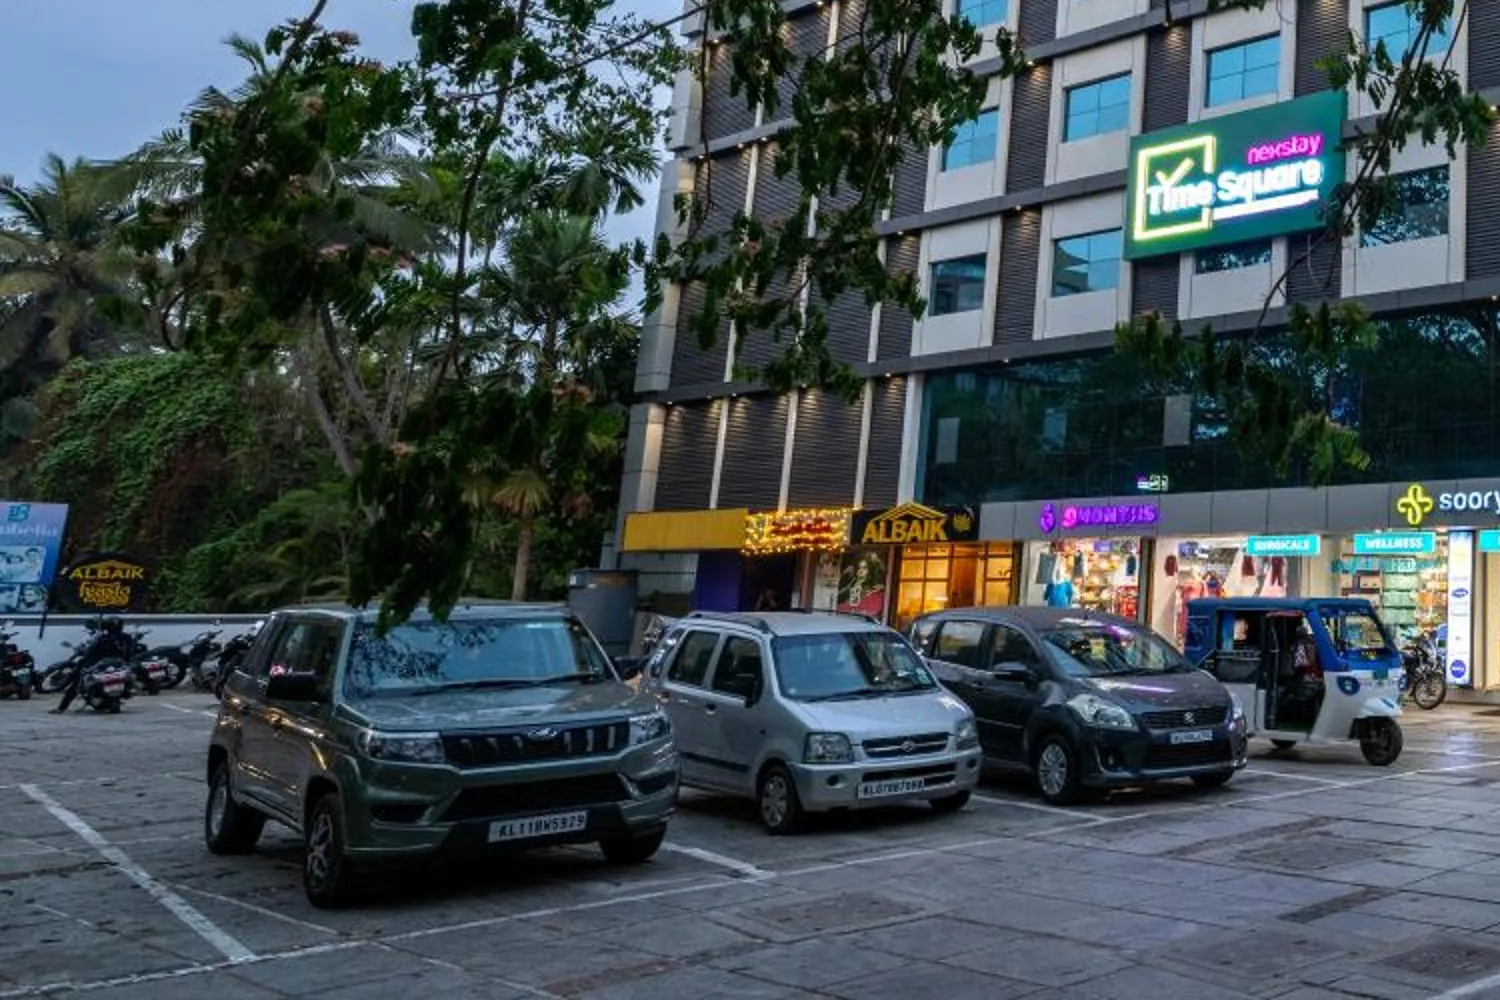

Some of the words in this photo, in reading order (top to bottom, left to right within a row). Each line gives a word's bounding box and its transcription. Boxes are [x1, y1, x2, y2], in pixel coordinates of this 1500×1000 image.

[1247, 134, 1322, 164] nexstay
[1146, 179, 1216, 216] Time
[1217, 158, 1324, 205] Square
[862, 518, 948, 544] ALBAIK
[1365, 537, 1424, 549] WELLNESS
[69, 567, 145, 580] ALBAIK
